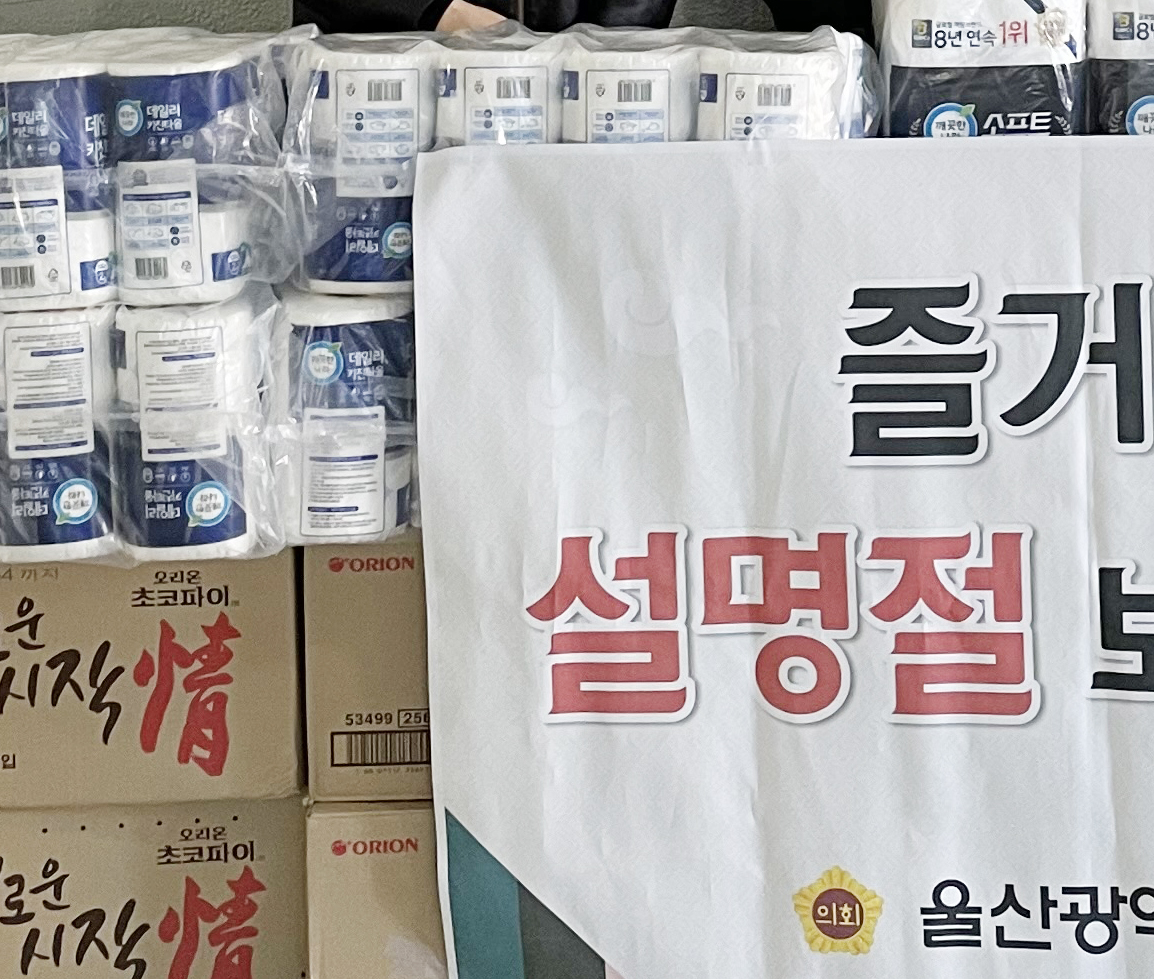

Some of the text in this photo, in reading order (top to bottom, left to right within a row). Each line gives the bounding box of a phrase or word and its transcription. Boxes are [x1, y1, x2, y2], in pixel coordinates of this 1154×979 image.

[934, 20, 1028, 48] 8년 연속 1위
[11, 108, 48, 126] 데일리
[146, 103, 182, 119] 데일리
[935, 121, 967, 132] 깨끗한
[349, 556, 416, 572] ORION
[153, 571, 201, 585] 오리온
[131, 585, 230, 608] 초코파이
[4, 596, 46, 651] 운
[526, 530, 1037, 716] 설명절
[132, 610, 242, 777] 情
[345, 713, 394, 726] 53499
[179, 827, 228, 842] 오리온
[156, 842, 256, 866] 초코파이
[352, 838, 420, 856] ORION
[0, 858, 70, 925] 로운
[814, 902, 862, 928] 의회
[19, 898, 151, 979] 시작
